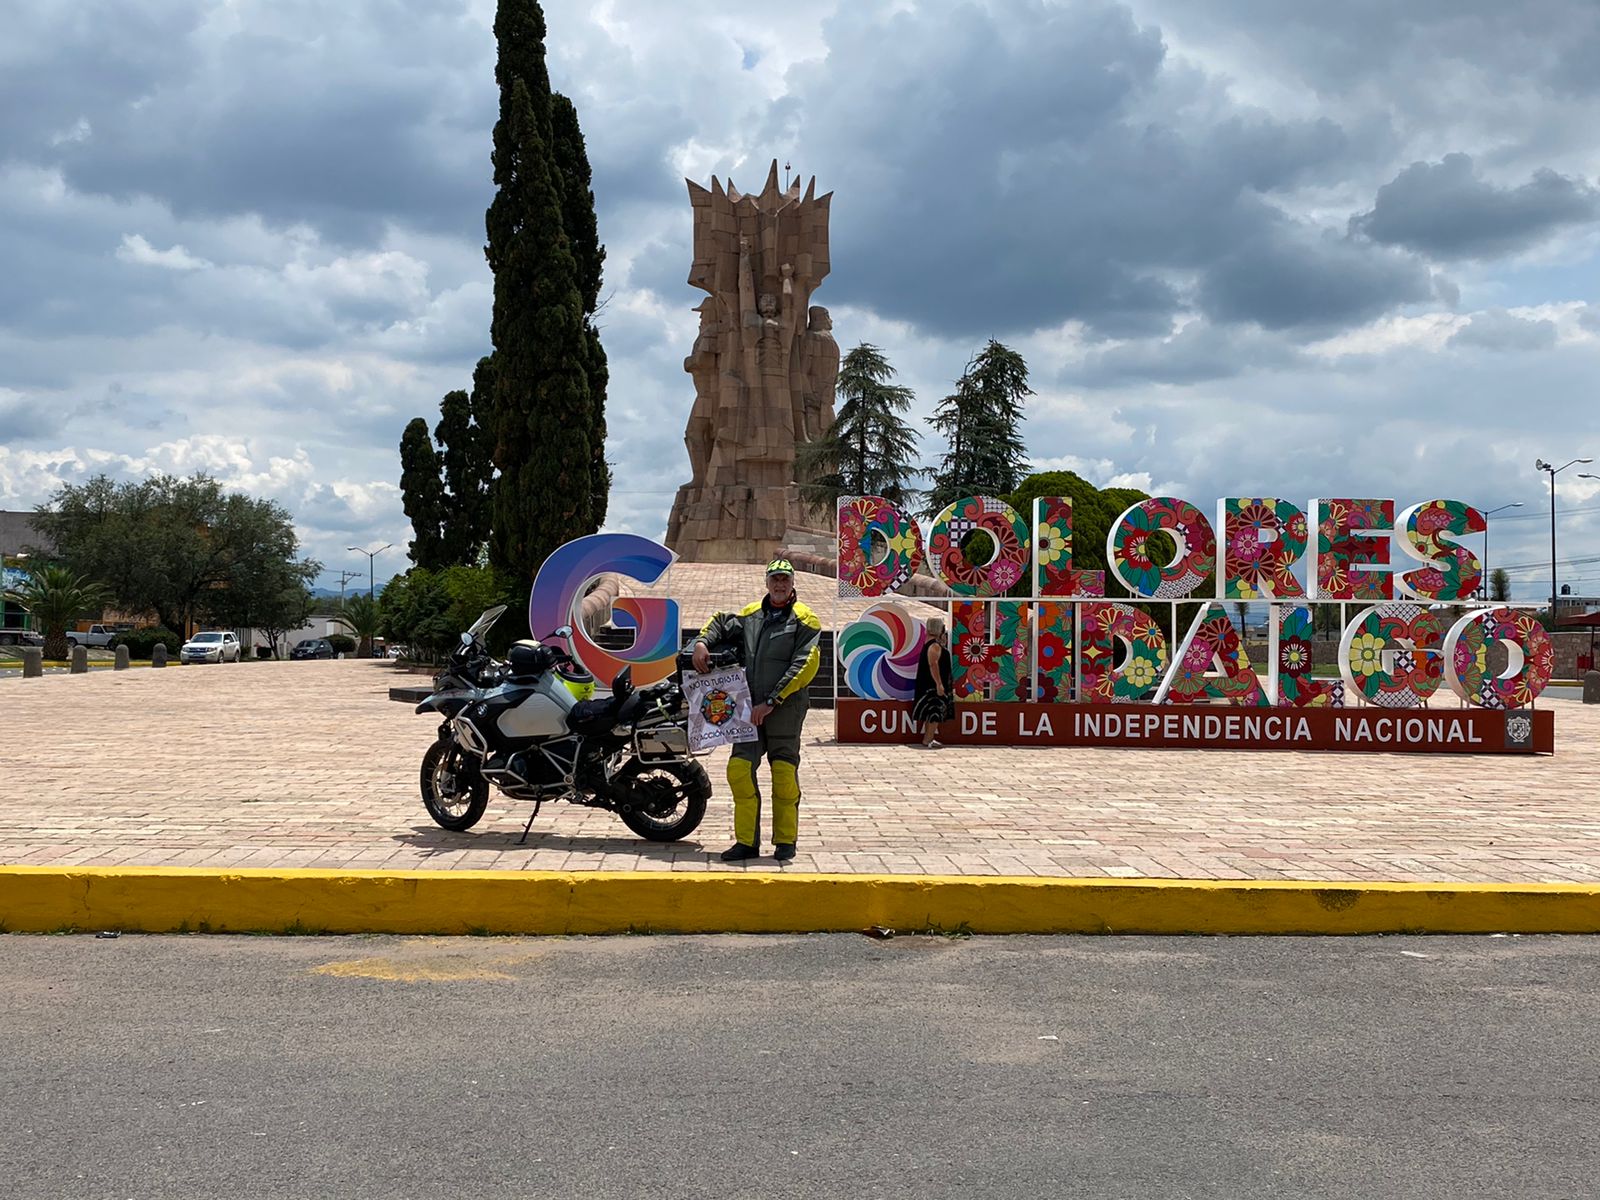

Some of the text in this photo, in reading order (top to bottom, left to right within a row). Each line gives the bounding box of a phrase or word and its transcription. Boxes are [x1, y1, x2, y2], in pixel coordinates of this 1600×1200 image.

[837, 495, 1487, 599] DOLORES
[711, 675, 740, 687] TURISTA
[949, 601, 1554, 709] HIDALGO
[961, 711, 998, 736] DE
[1018, 712, 1054, 737] LA
[1074, 712, 1313, 741] INDEPENDENCIA
[1334, 716, 1482, 744] NACIONAL
